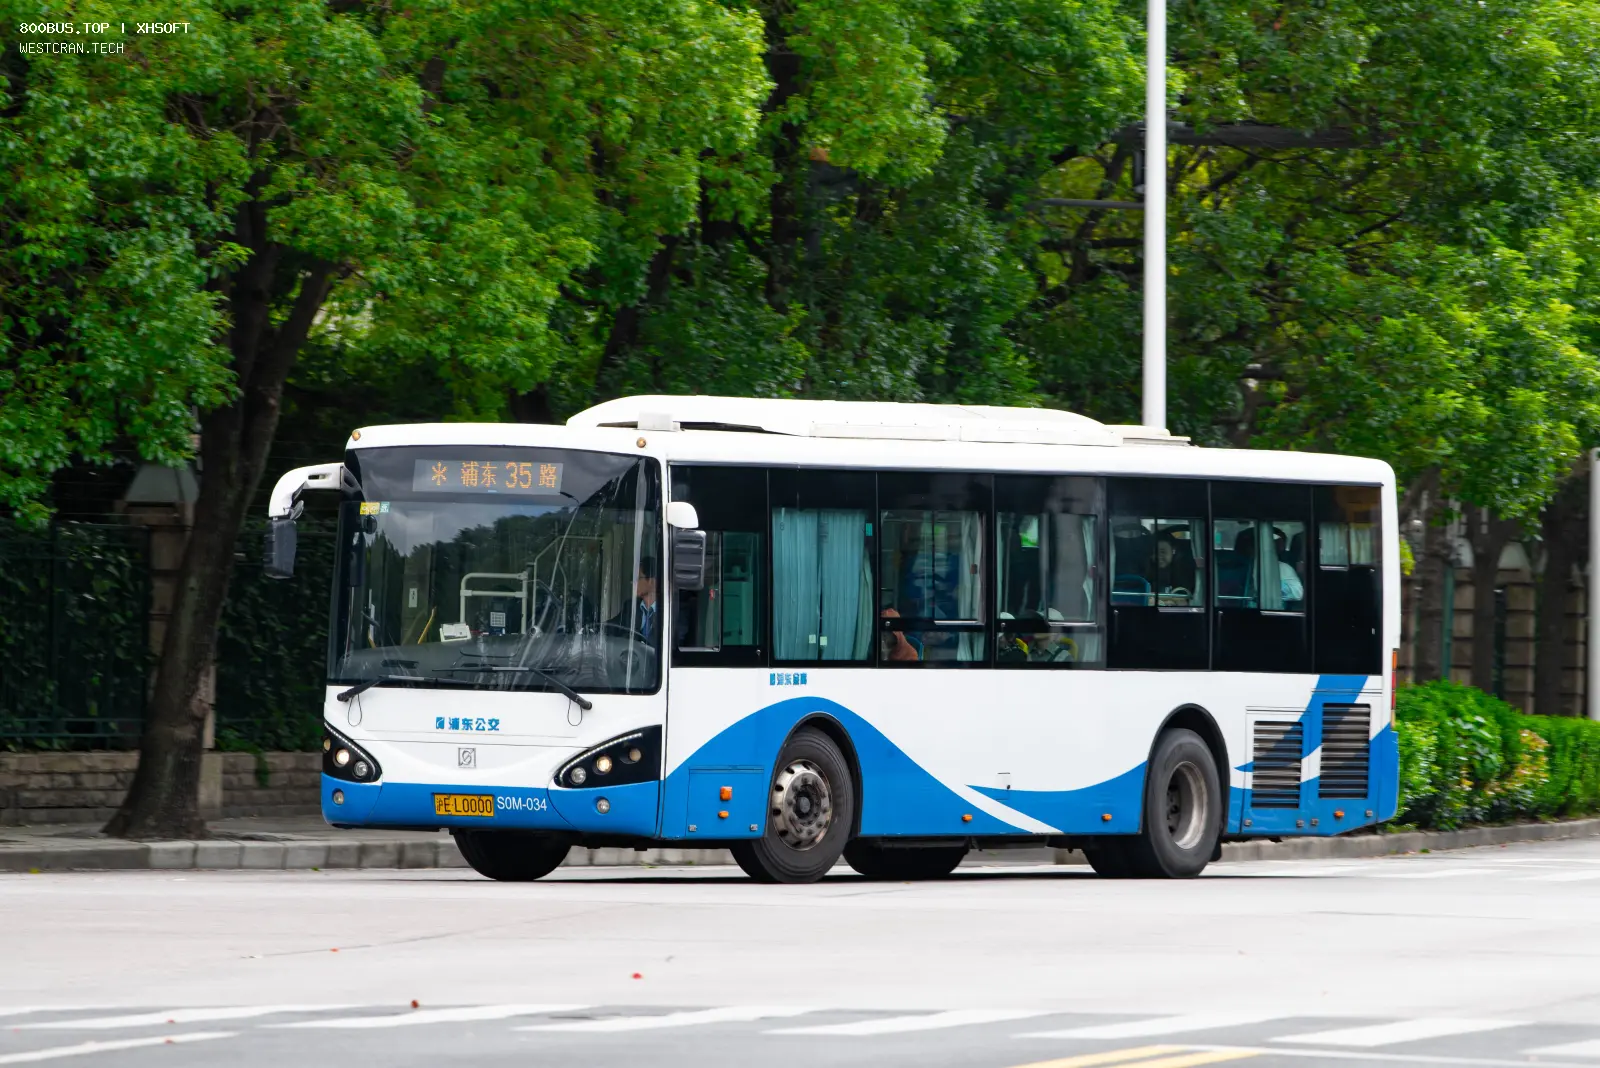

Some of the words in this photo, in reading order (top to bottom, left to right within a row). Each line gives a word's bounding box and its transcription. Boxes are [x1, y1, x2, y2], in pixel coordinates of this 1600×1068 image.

[461, 460, 498, 487] 浦东
[505, 461, 532, 489] 35
[538, 463, 557, 488] 路
[448, 717, 500, 731] 浦东公交
